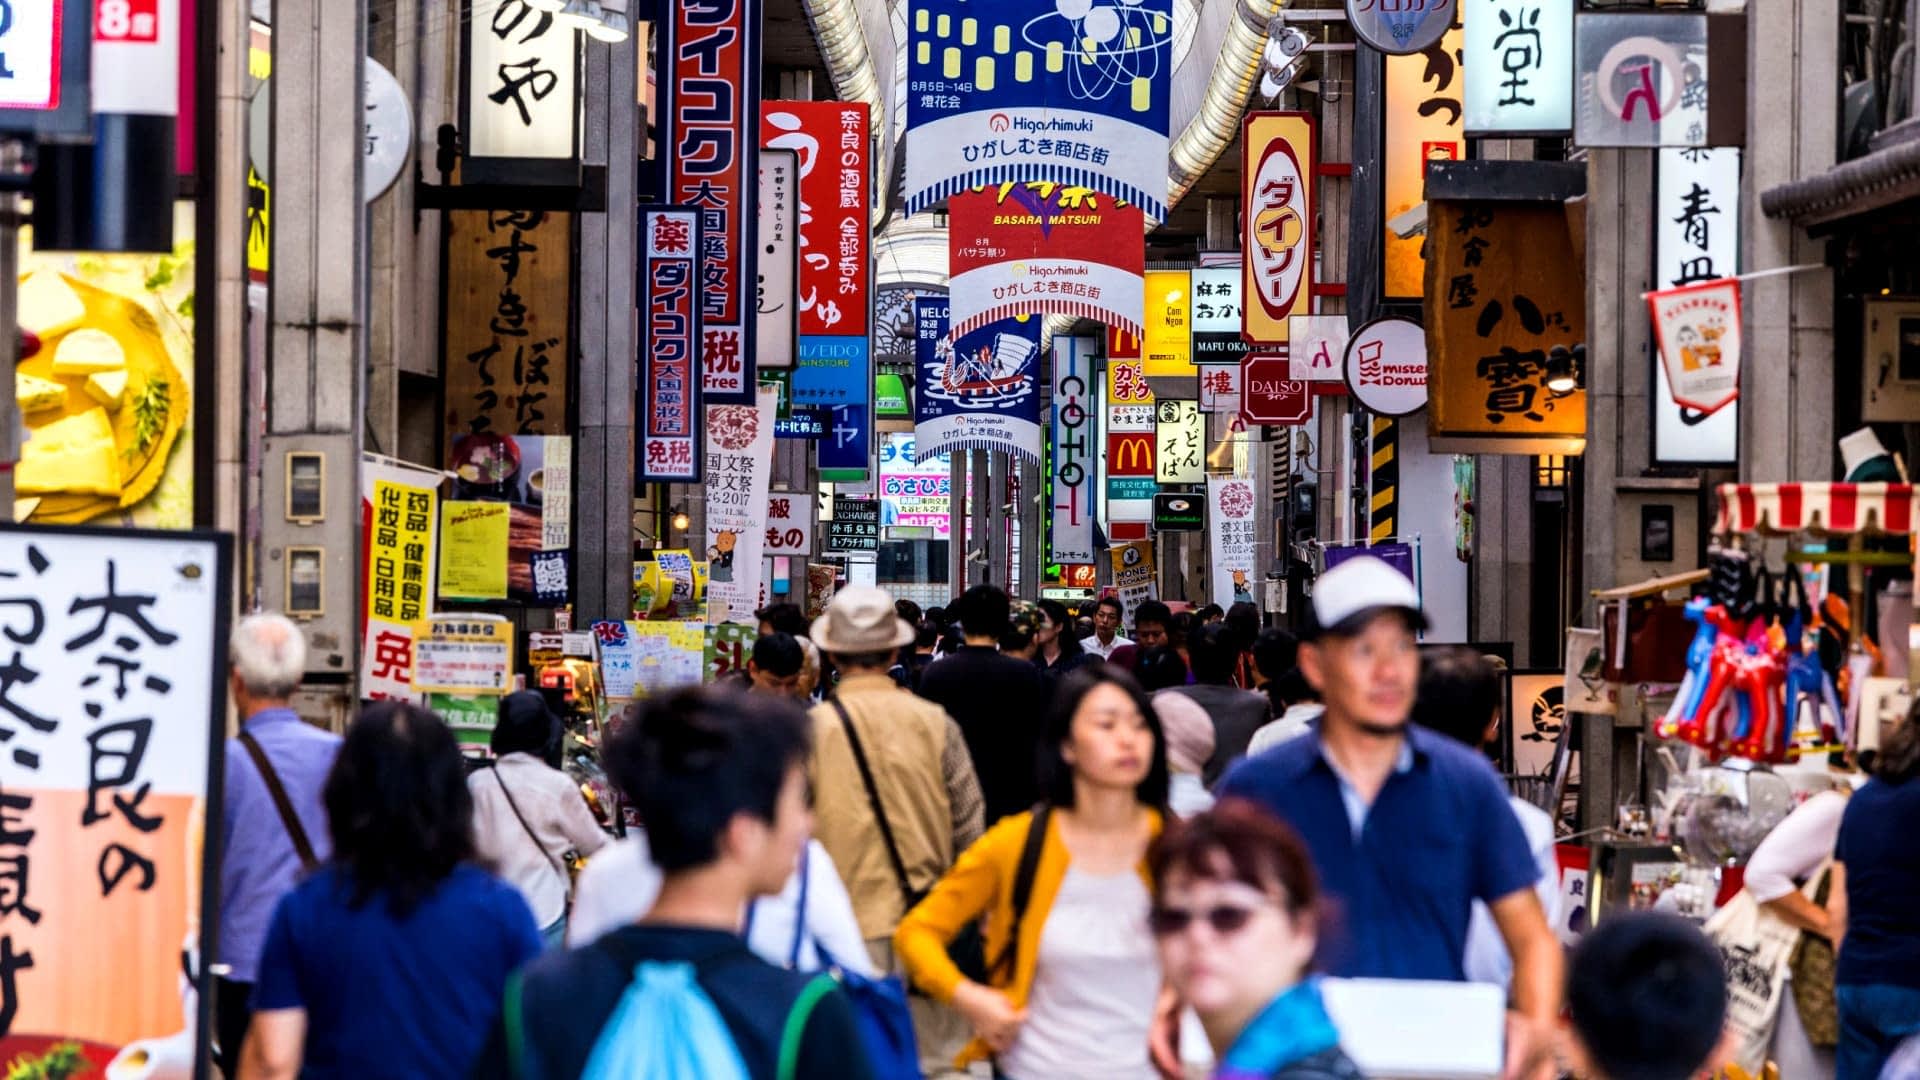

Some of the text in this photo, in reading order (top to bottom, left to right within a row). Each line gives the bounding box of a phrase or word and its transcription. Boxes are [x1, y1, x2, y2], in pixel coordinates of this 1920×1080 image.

[1392, 24, 1415, 38] 2F
[921, 95, 961, 109] 燈花会
[1013, 116, 1093, 134] Higashimuki
[840, 110, 861, 209] 奈良の酒蔵
[962, 138, 1110, 166] ひがしむき商店街
[993, 215, 1101, 225] BASARA MATSURI
[654, 214, 690, 254] 薬
[1260, 176, 1297, 299] ダイソー
[975, 238, 989, 246] 8月
[958, 247, 1006, 258] バサラ祭り
[1029, 265, 1089, 276] Higashimuki
[992, 281, 1101, 300] ひがしむき商店街
[1196, 281, 1232, 297] 麻布
[653, 262, 690, 363] ダイコク
[1196, 304, 1242, 319] おか
[1197, 342, 1250, 352] MAFU OKA
[1251, 380, 1303, 393] DAISO
[1267, 393, 1289, 401] ダイソー
[942, 428, 1014, 441] ひがしむき商店街
[1060, 376, 1085, 488] COTO
[1182, 406, 1200, 468] うどん
[646, 439, 691, 465] 免税
[1162, 437, 1181, 477] そば
[647, 463, 690, 474] Tax-Free
[706, 453, 755, 473] 国文祭
[768, 498, 790, 519] 級
[835, 502, 870, 512] MONE
[1055, 551, 1089, 559] コトモール
[1117, 565, 1150, 580] MONEY
[65, 559, 179, 896] 奈良の
